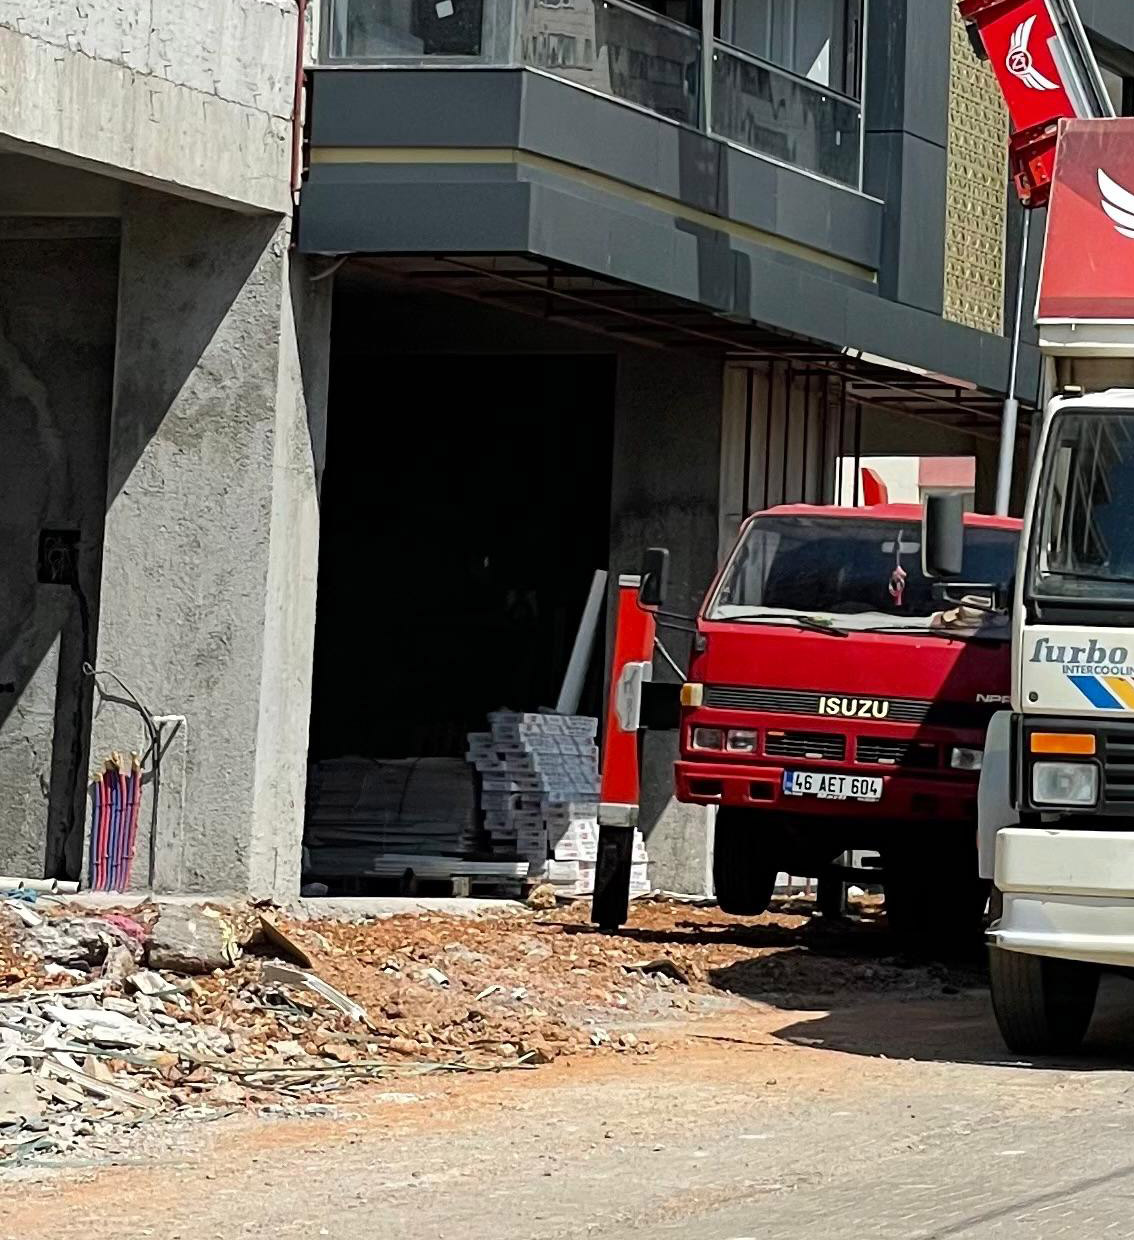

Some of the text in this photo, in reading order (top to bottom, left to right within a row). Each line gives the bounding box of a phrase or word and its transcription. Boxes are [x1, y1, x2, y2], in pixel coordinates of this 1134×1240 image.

[818, 695, 890, 719] ISUZU
[795, 773, 813, 791] 46
[819, 775, 846, 794] AET
[851, 778, 878, 796] 604
